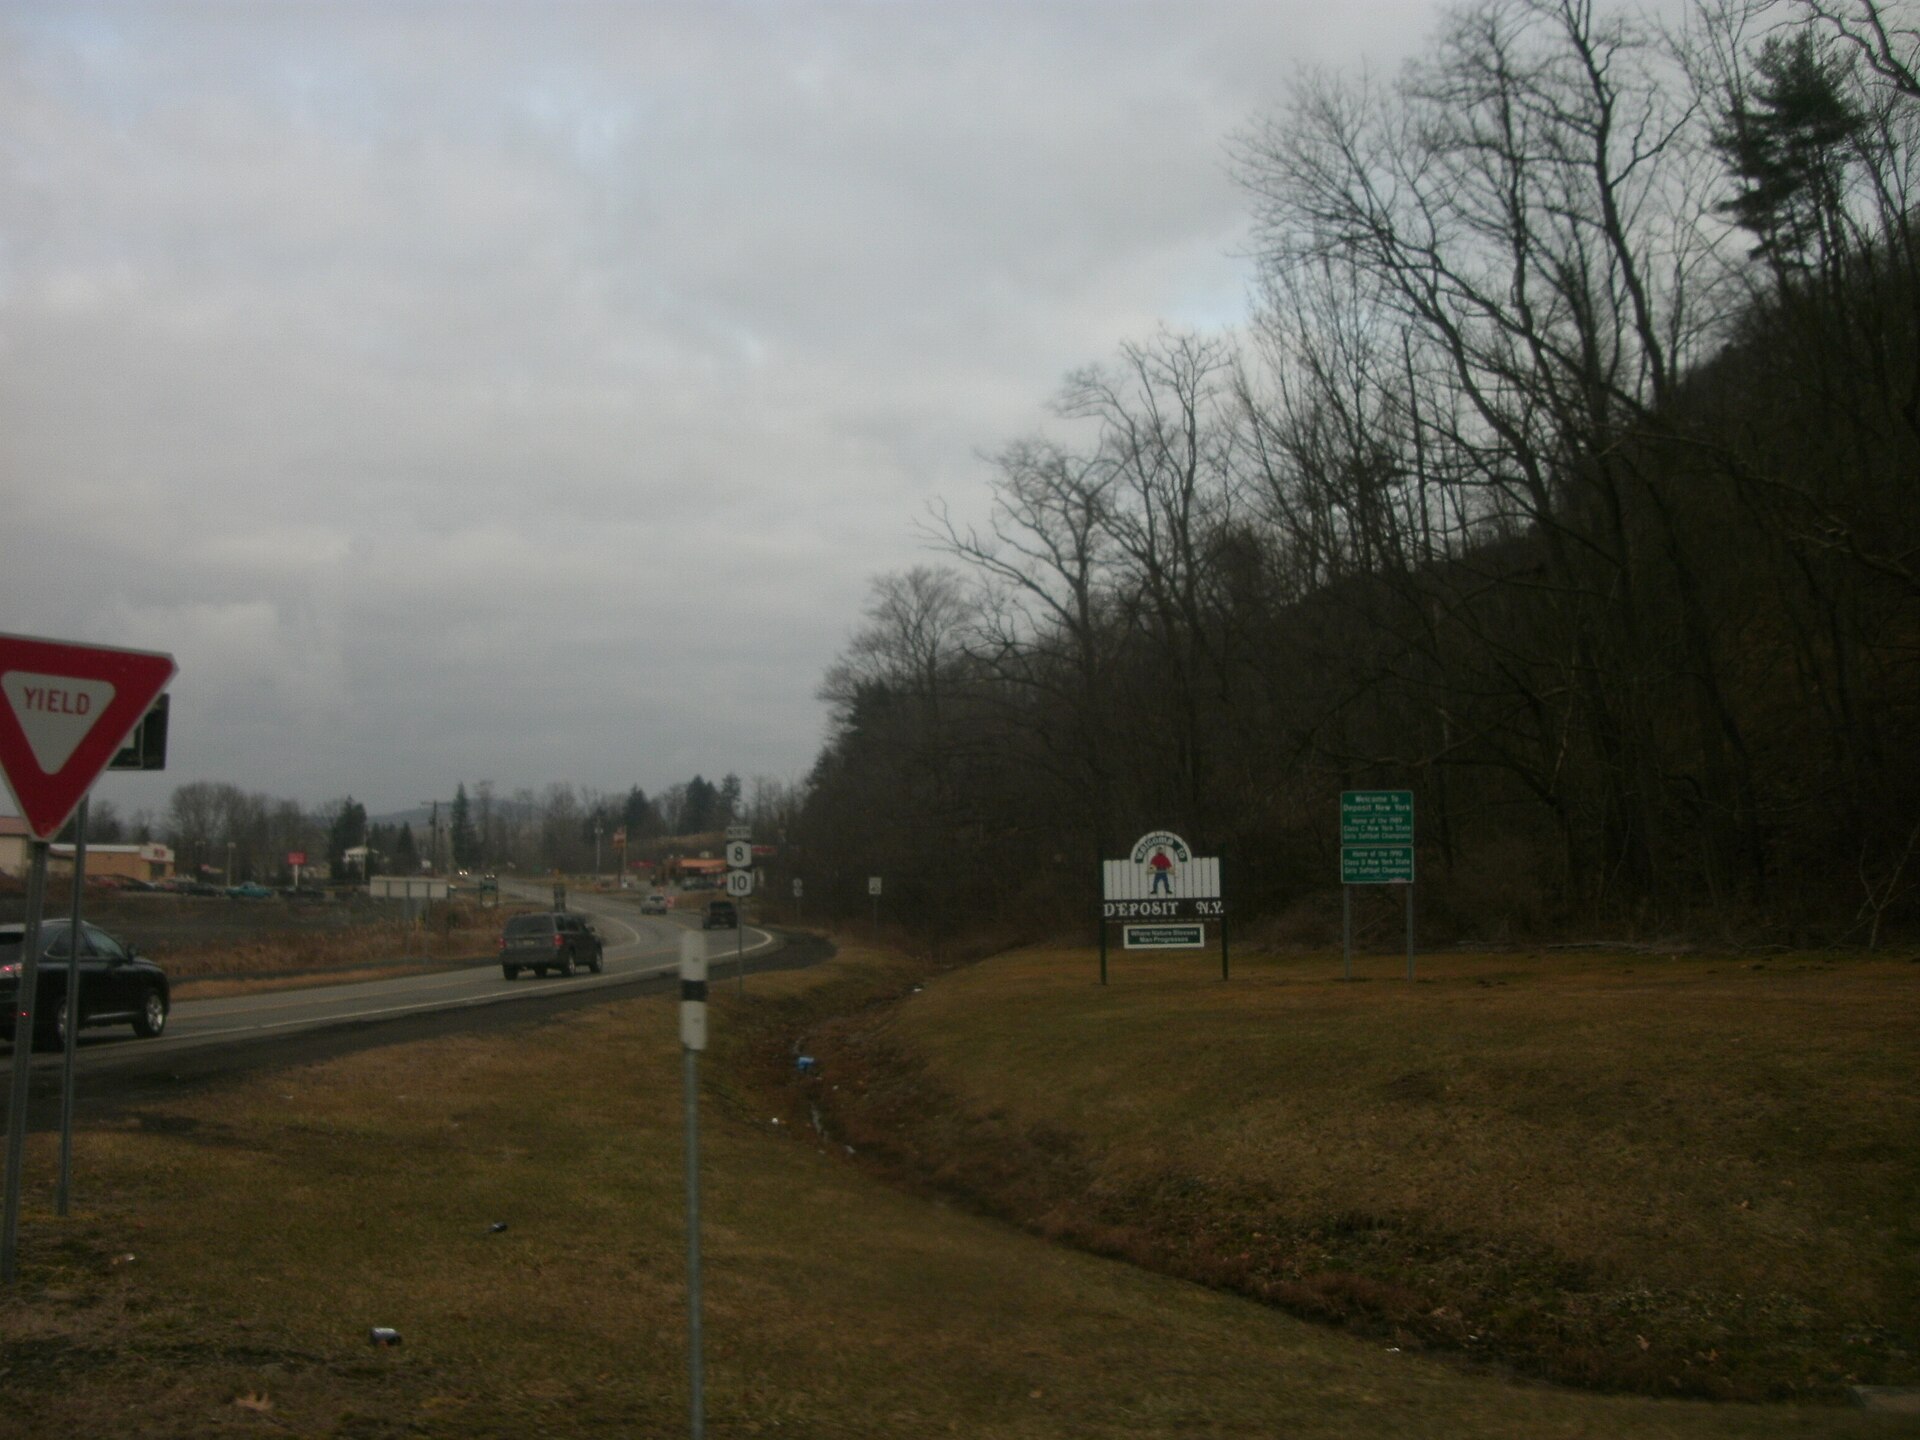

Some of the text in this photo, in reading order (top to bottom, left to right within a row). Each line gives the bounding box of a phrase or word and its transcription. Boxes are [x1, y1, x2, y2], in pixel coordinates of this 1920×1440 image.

[23, 686, 91, 716] YIELD
[1354, 795, 1388, 803] Welcome
[1343, 803, 1411, 812] Deposit New York
[734, 846, 744, 862] 8
[1136, 836, 1174, 860] Welcome
[732, 875, 748, 890] 10
[1104, 901, 1224, 917] DEPOSIT N.Y.
